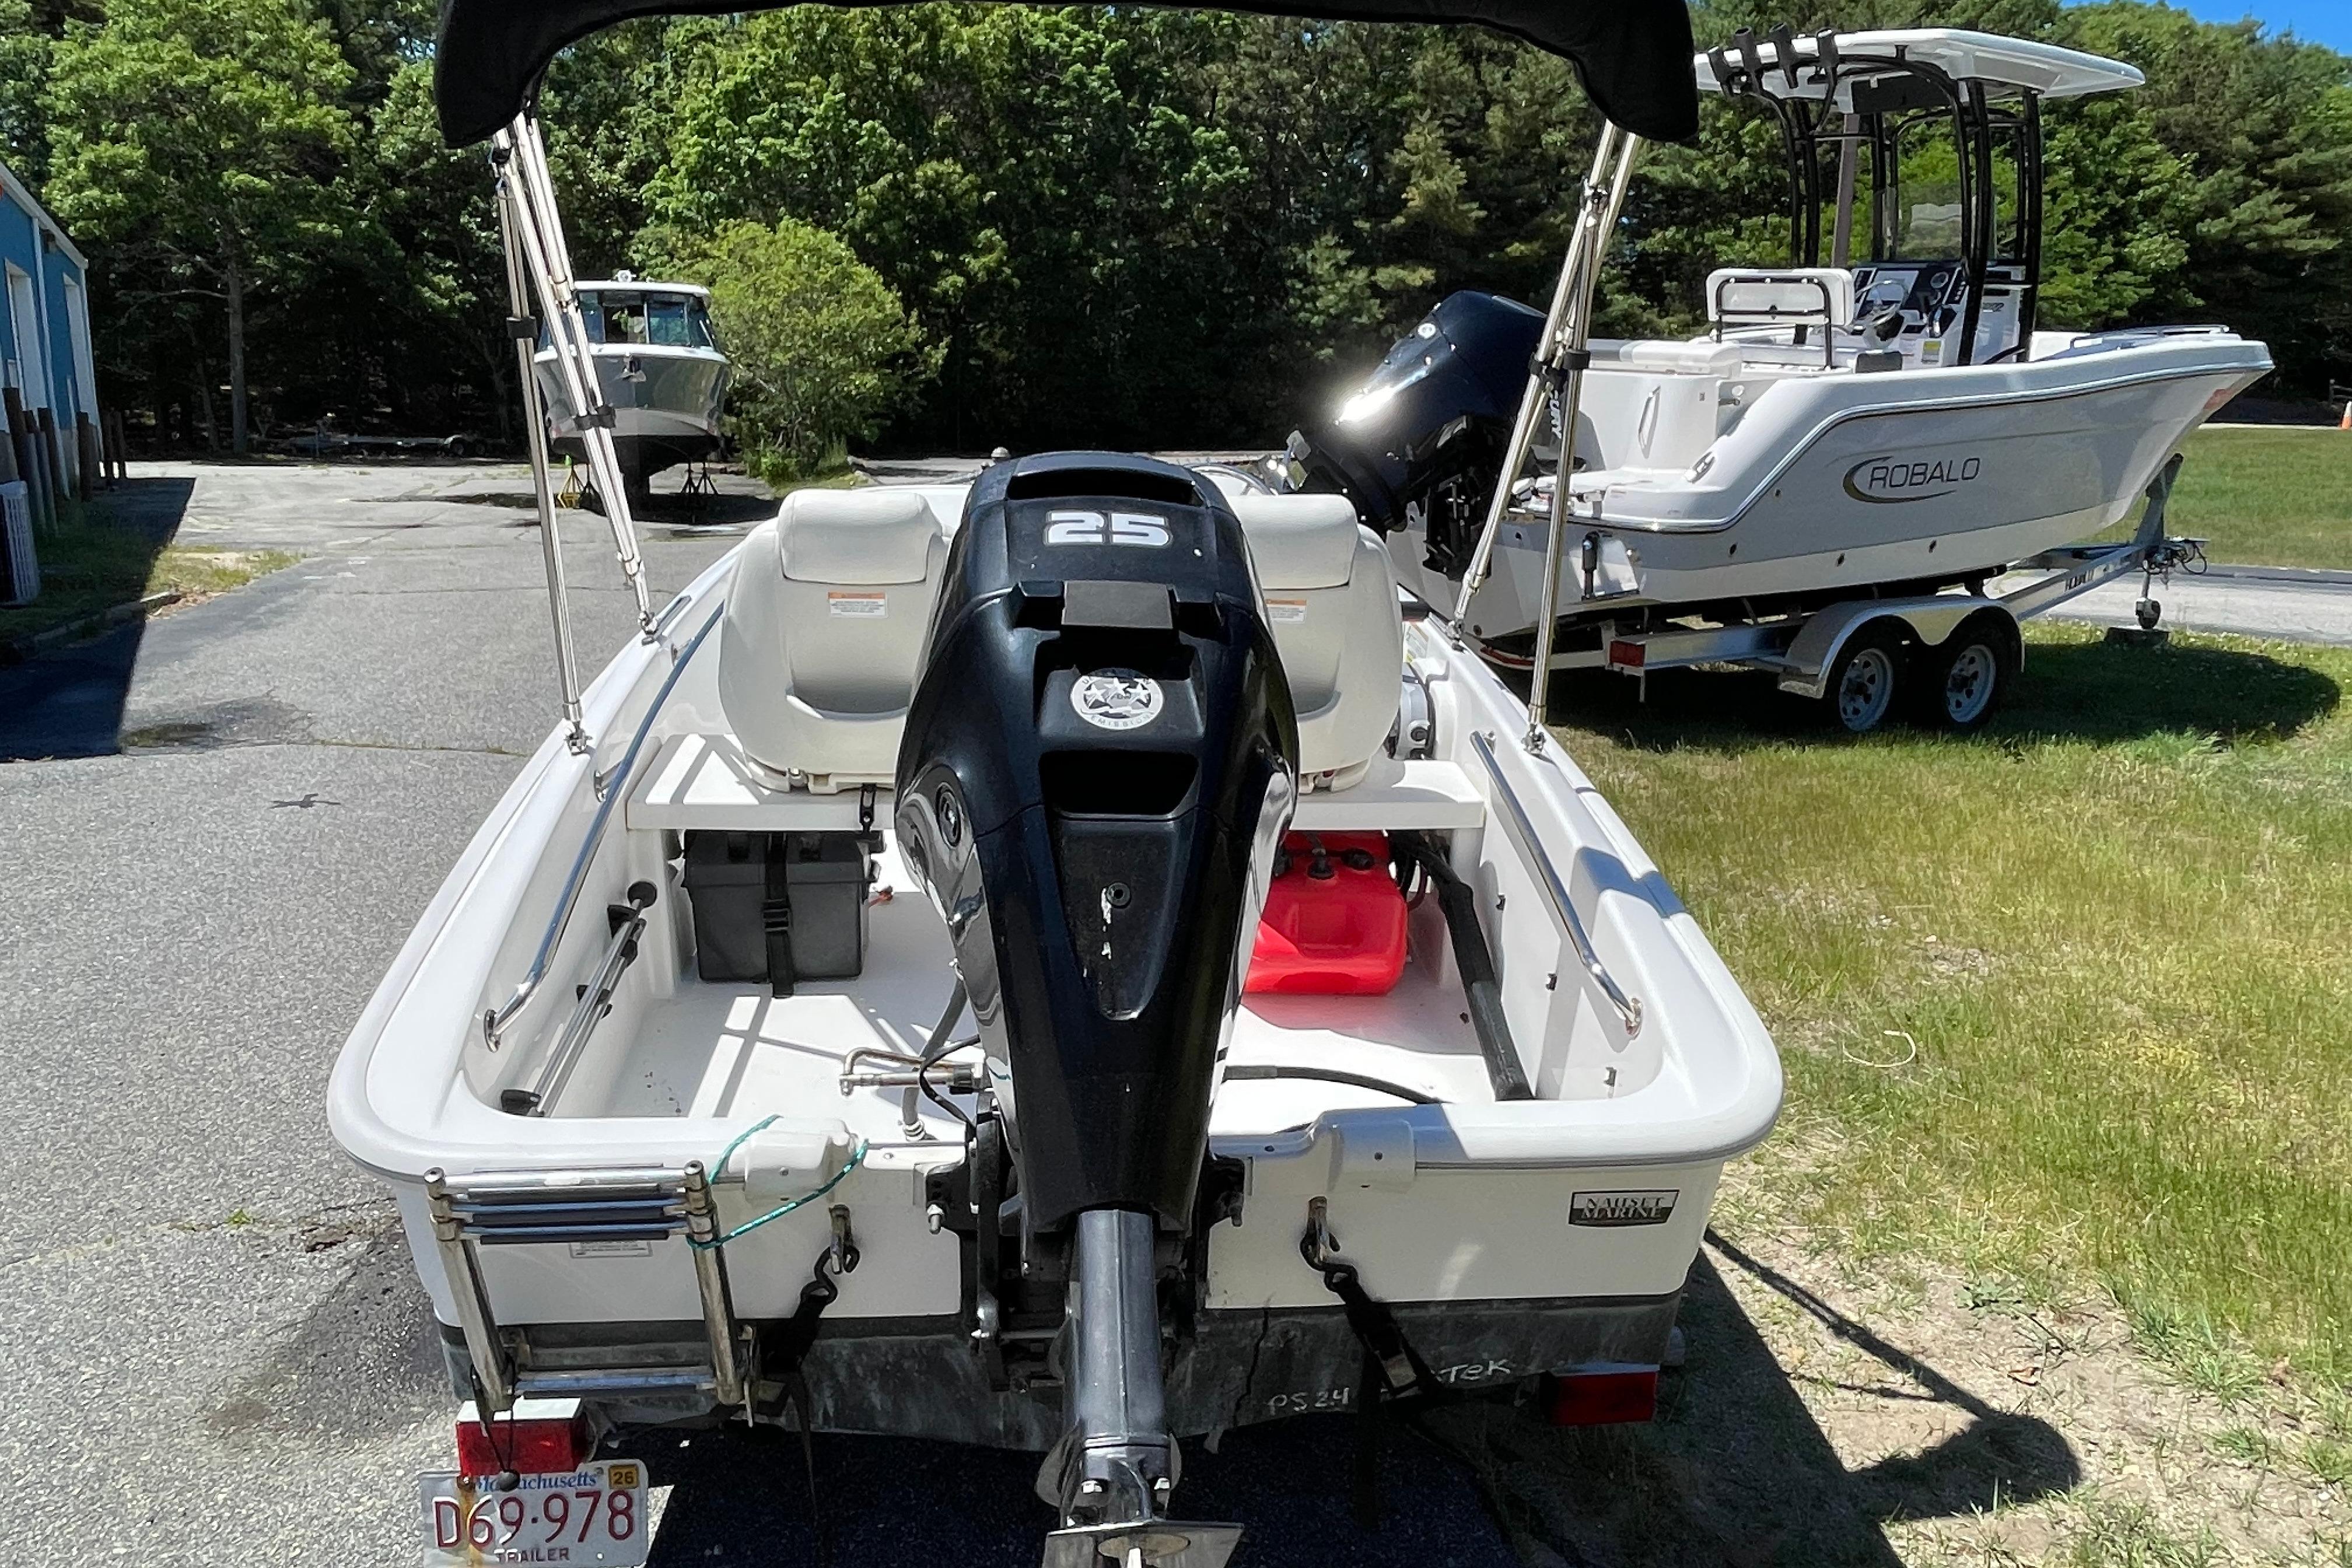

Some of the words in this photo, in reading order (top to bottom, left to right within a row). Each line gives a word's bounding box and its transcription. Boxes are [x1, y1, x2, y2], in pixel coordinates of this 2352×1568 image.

[1868, 457, 1980, 491] ROBALO
[1047, 510, 1171, 547] 25
[612, 1472, 634, 1485] 26
[494, 1547, 570, 1564] TRAILER
